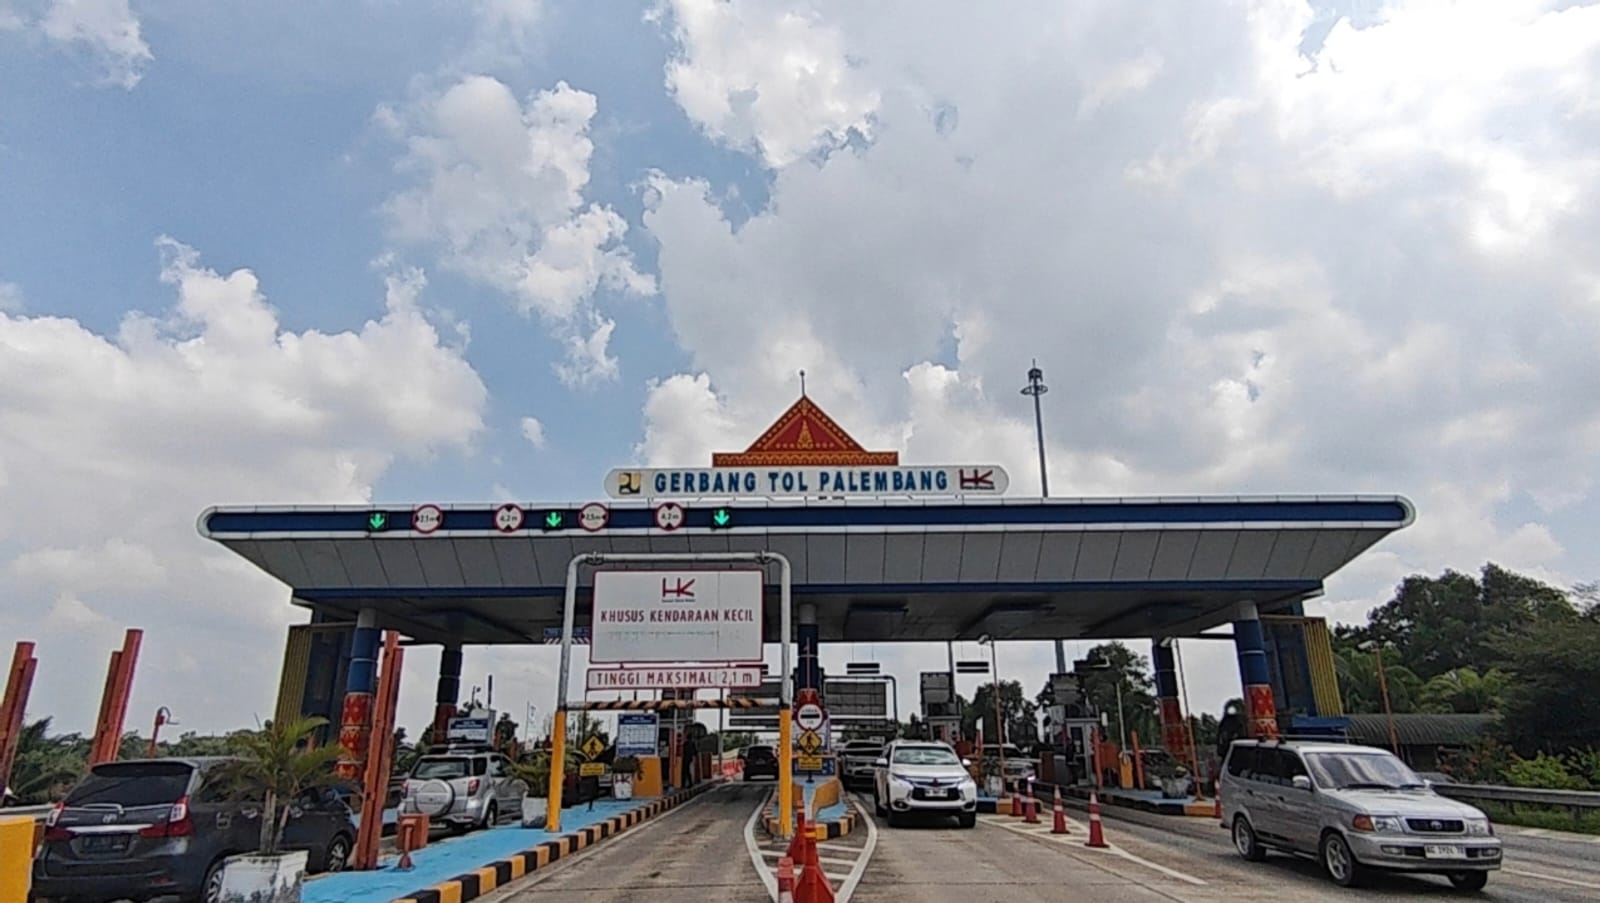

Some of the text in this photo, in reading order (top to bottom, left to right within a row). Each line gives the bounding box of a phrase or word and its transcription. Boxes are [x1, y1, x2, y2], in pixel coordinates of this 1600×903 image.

[654, 470, 948, 493] GERBANG TOL PALEMBANG
[958, 468, 994, 485] HK
[662, 577, 695, 597] HK
[601, 608, 754, 623] KHUSUS KENDARAAN KECIL
[597, 671, 752, 686] TINGGI MAKSIMAL 2,1 m
